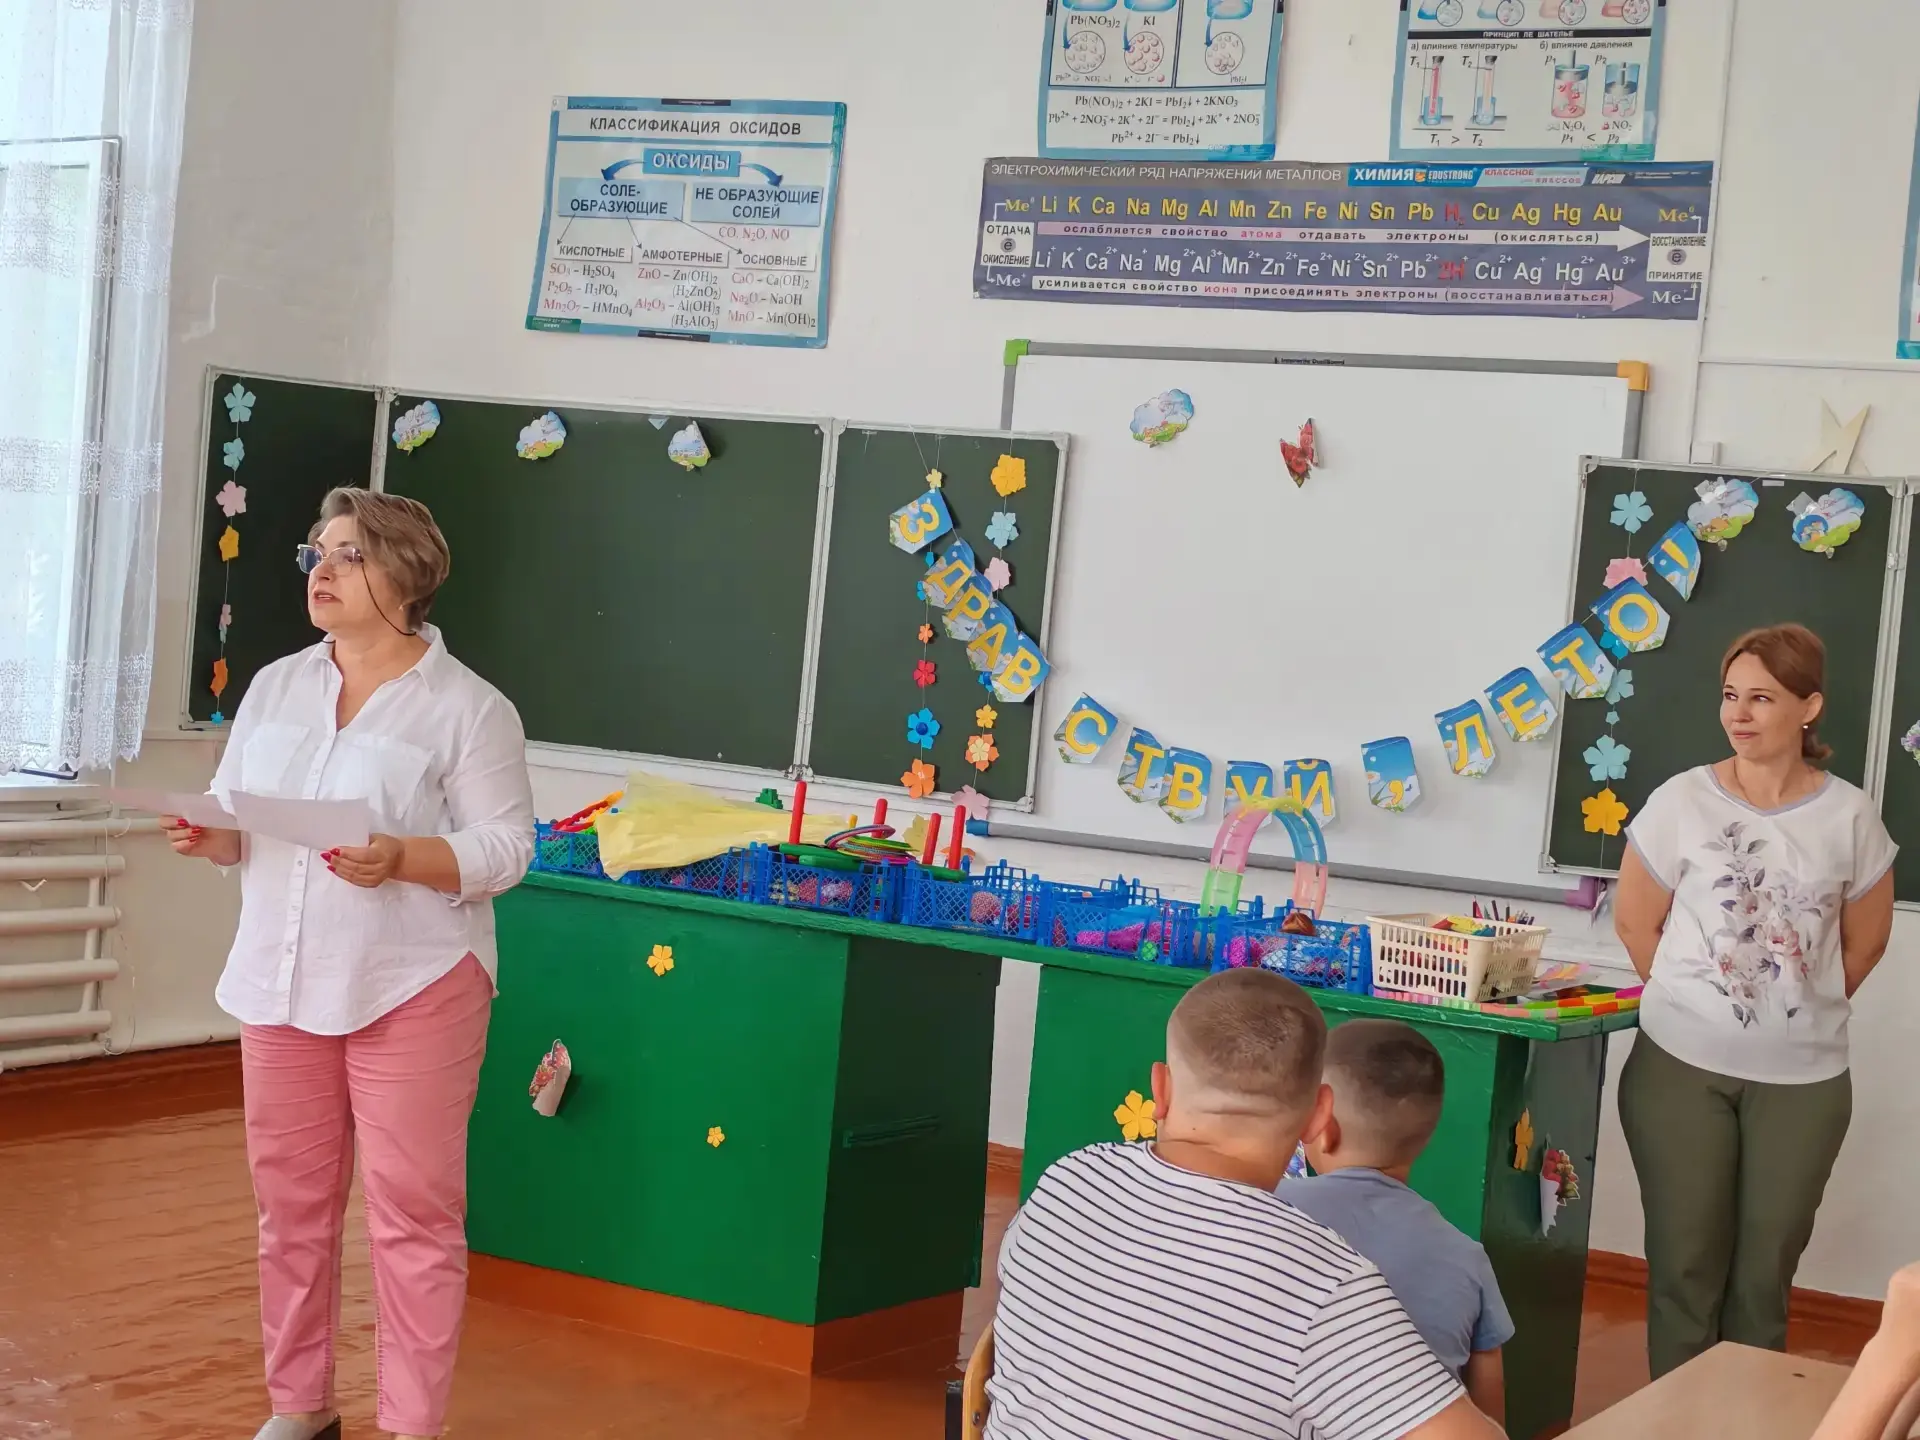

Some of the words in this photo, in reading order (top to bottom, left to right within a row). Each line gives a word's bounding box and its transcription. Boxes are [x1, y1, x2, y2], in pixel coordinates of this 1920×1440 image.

[1143, 15, 1156, 26] KI
[1537, 30, 1574, 38] ШАТЕЛЬЕ
[1410, 42, 1420, 51] а)
[1460, 42, 1518, 52] температуры
[1539, 40, 1549, 51] б)
[1551, 41, 1588, 49] влияние
[1589, 41, 1633, 50] давления
[1135, 96, 1153, 107] 2KI
[1203, 95, 1239, 108] 2KNO3
[589, 117, 720, 136] КЛАССИФИКАЦИЯ
[729, 121, 801, 137] ОКСИДОВ
[652, 152, 731, 173] ОКСИДЫ
[991, 163, 1136, 178] ЭЛЕКТРОХИМИЧЕСКИЙ
[1139, 167, 1166, 179] РЯД
[1168, 167, 1263, 180] НАПРЯЖЕНИЙ
[1265, 168, 1342, 181] МЕТАЛЛОВ
[1353, 168, 1414, 181] ХИМИЯ
[600, 183, 641, 197] СОЛЕ-
[695, 187, 714, 201] НЕ
[718, 187, 820, 204] ОБРАЗУЮЩИЕ
[570, 198, 668, 215] ОБРАЗУЮЩИЕ
[732, 204, 781, 220] СОЛЕЙ
[1041, 195, 1057, 213] Li
[1068, 195, 1082, 214] K
[1091, 196, 1116, 215] Ca
[1126, 198, 1150, 216] Na
[1161, 198, 1189, 221] Mg
[1198, 199, 1218, 217] Al
[1229, 199, 1256, 219] Mn
[1267, 200, 1292, 219] Zn
[1304, 201, 1328, 220] Fe
[1338, 201, 1359, 220] Ni
[1369, 201, 1395, 221] Sn
[1407, 202, 1434, 221] Pb
[1472, 202, 1500, 221] Cu
[1511, 202, 1541, 226] Ag
[1553, 203, 1582, 226] Hg
[1592, 203, 1622, 222] Au
[771, 228, 790, 241] NO
[986, 224, 1031, 236] ОТДАЧА
[1063, 224, 1152, 236] ослабляется
[1161, 225, 1228, 238] свойство
[1240, 229, 1283, 239] атома
[1299, 230, 1366, 241] отдавать
[1386, 231, 1469, 242] электроны
[1494, 231, 1600, 243] (окисляться)
[1651, 236, 1707, 247] ВОССТАНОВЛЕНИЕ
[559, 245, 625, 258] КИСЛОТНЫЕ
[642, 249, 723, 263] АМФОТЕРНЫЕ
[742, 254, 808, 267] ОСНОВНЫЕ
[982, 253, 1030, 266] ОКИСЛЕНИЕ
[637, 267, 661, 280] ZnO
[731, 272, 755, 285] CaO
[1648, 271, 1703, 280] ПРИНЯТИЕ
[1038, 279, 1126, 290] усиливается
[1132, 281, 1198, 293] свойство
[1204, 284, 1238, 294] иона
[1244, 286, 1349, 298] присоединять
[1356, 289, 1438, 301] электроны
[1445, 290, 1614, 304] (восстанавливаться)
[769, 292, 803, 306] NaOH
[728, 309, 755, 323] MnO
